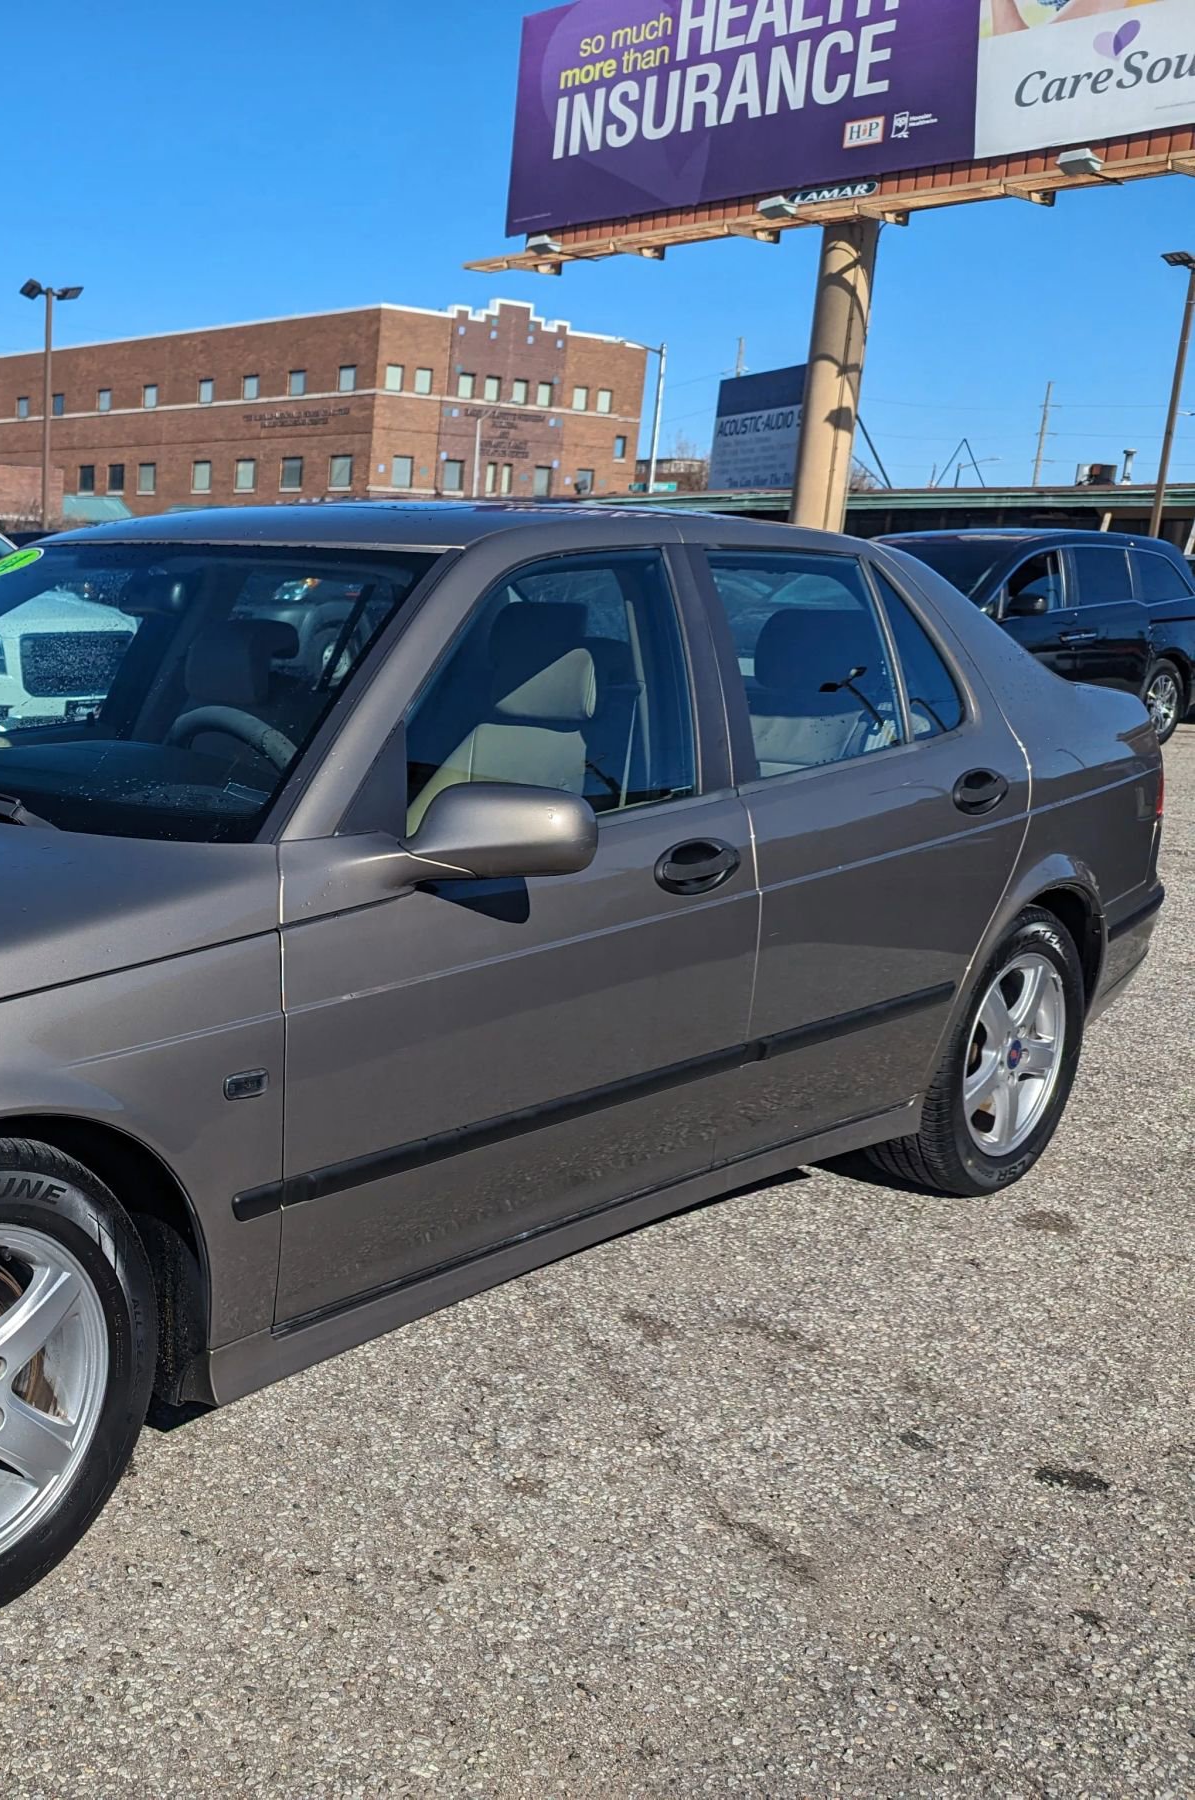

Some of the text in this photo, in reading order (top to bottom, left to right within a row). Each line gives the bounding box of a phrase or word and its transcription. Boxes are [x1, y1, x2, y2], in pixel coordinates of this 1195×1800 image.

[579, 16, 673, 58] so much
[675, 0, 900, 62] HEAL
[552, 19, 897, 161] INSURANCE
[559, 44, 670, 90] more than
[793, 183, 869, 205] LAMAR
